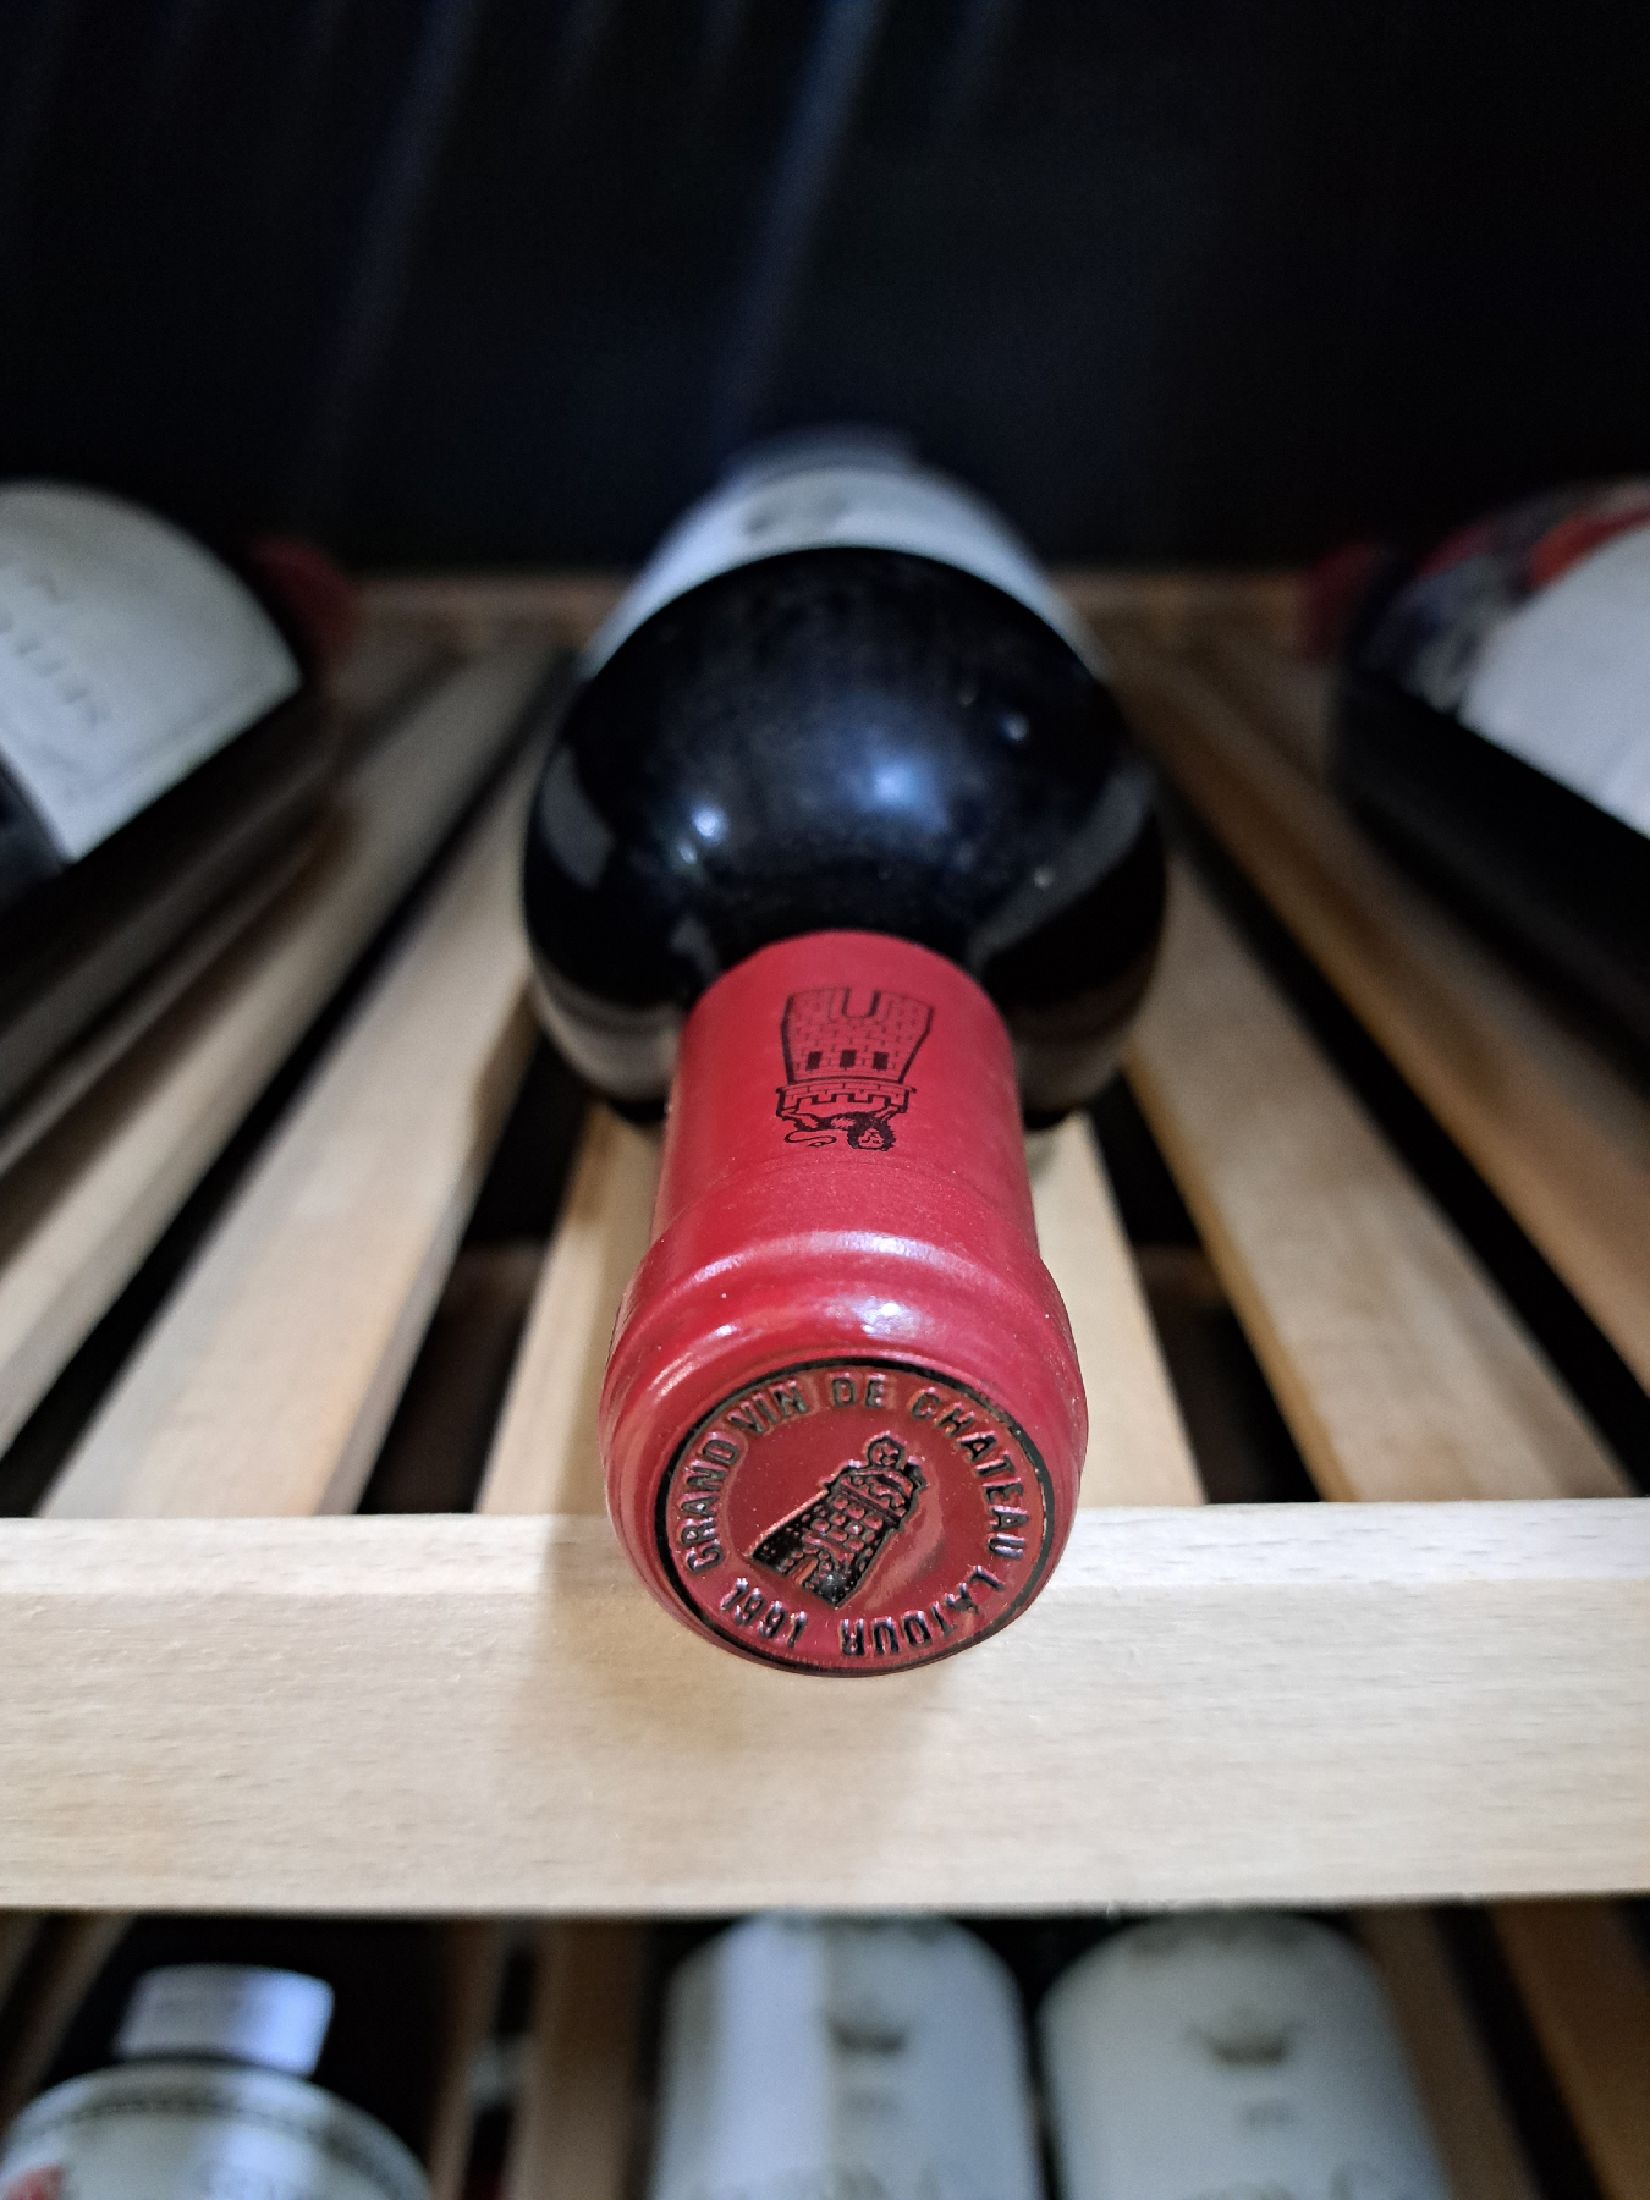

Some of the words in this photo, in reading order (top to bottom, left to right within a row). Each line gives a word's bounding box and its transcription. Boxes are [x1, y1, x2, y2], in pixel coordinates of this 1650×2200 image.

[728, 1379, 808, 1436] VIN
[831, 1372, 888, 1408] DE
[678, 1431, 739, 1573] GRAND
[911, 1387, 1029, 1559] CHATEAU
[720, 1577, 807, 1648] 1991
[839, 1565, 1005, 1657] LATOUR
